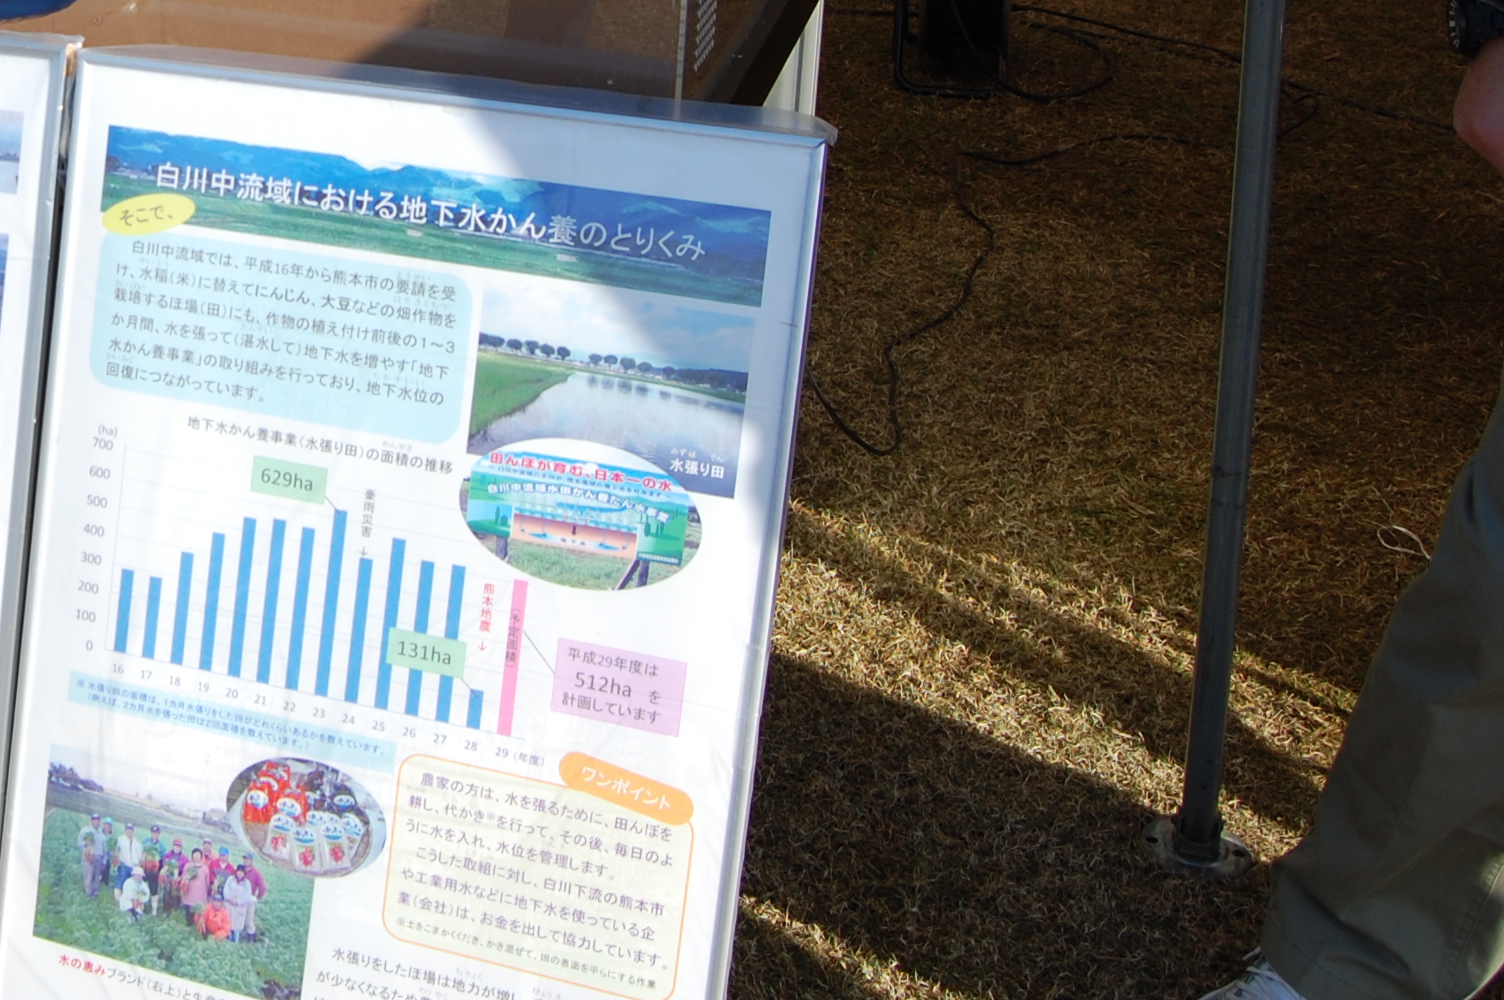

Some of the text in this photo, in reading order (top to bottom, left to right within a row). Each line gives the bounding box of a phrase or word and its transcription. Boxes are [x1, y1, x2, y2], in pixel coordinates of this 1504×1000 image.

[118, 206, 176, 227] そこで、
[156, 162, 706, 261] 白川中流域における地下水かん養のとりくみ
[132, 240, 457, 302] 白川中流域では、平成16年から熊本市の要請を受
[116, 262, 457, 328] け、水稲（米）に替えてにんじん、大豆などの畑作物を
[111, 312, 450, 378] か月間、水を張って（湛水して）地下水を増やす「地下
[106, 361, 265, 403] 回復につながっています。
[109, 338, 445, 405] 水かん養事業」の取り組みを行っており、地下水位の
[92, 436, 114, 450] 700
[187, 416, 454, 475] 地下水かん養事業（水張り田）の面積の推移
[89, 466, 111, 479] 600
[260, 467, 313, 492] 629ha
[669, 458, 725, 479] 水張り田
[86, 495, 108, 508] 500
[83, 524, 105, 537] 400
[80, 553, 102, 566] 300
[78, 581, 99, 595] 200
[75, 608, 96, 623] 100
[479, 582, 495, 633] 熊本地震
[85, 639, 93, 651] 0
[397, 640, 452, 666] 131ha
[567, 647, 659, 677] 平成29年度は
[574, 671, 662, 705] 512ha を
[111, 663, 124, 674] 16
[140, 670, 153, 680] 17
[168, 675, 181, 686] 18
[197, 682, 210, 693] 19
[225, 688, 239, 699] 20
[254, 694, 266, 706] 21
[283, 701, 296, 712] 22
[312, 707, 325, 719] 23
[341, 713, 355, 725] 24
[372, 720, 385, 732] 25
[402, 727, 416, 739] 26
[433, 733, 447, 745] 27
[464, 739, 478, 751] 28
[495, 746, 509, 758] 29
[562, 691, 661, 724] 計画しています
[420, 772, 674, 842] 農家の方は、水を張るために、田んぼを
[581, 765, 671, 811] ワンポイント
[405, 818, 615, 880] うに水を入れ、水位を管理します。
[416, 846, 666, 917] こうした取組に対し、白川下流の熊本市
[401, 867, 655, 941] や工業用水などに地下水を使っている企
[397, 890, 668, 970] 業（会社）は、お金を出して協力しています。
